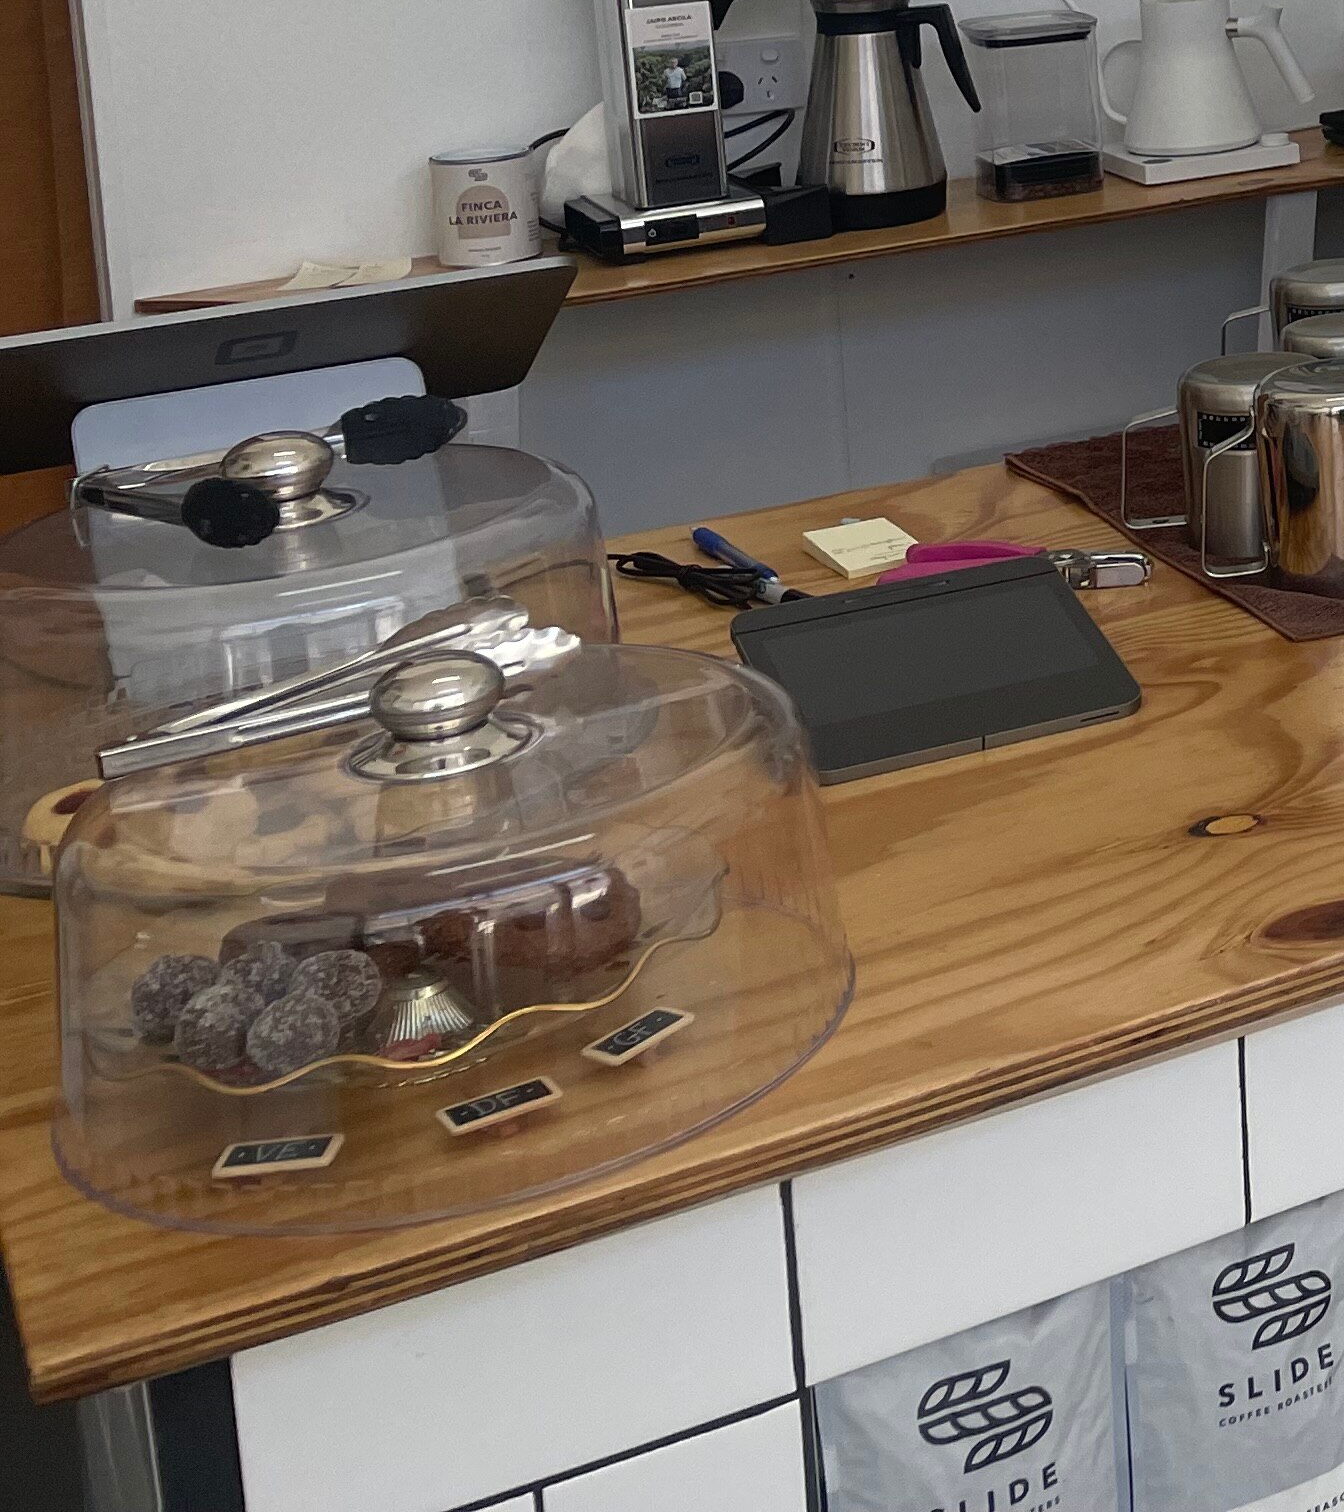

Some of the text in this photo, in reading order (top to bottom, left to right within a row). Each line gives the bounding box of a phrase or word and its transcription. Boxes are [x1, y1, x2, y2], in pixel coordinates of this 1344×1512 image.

[461, 200, 503, 212] FINCA
[448, 211, 519, 226] LA RIVIERA
[1218, 1342, 1335, 1409] SLIDE
[1219, 1404, 1271, 1428] COFFEE
